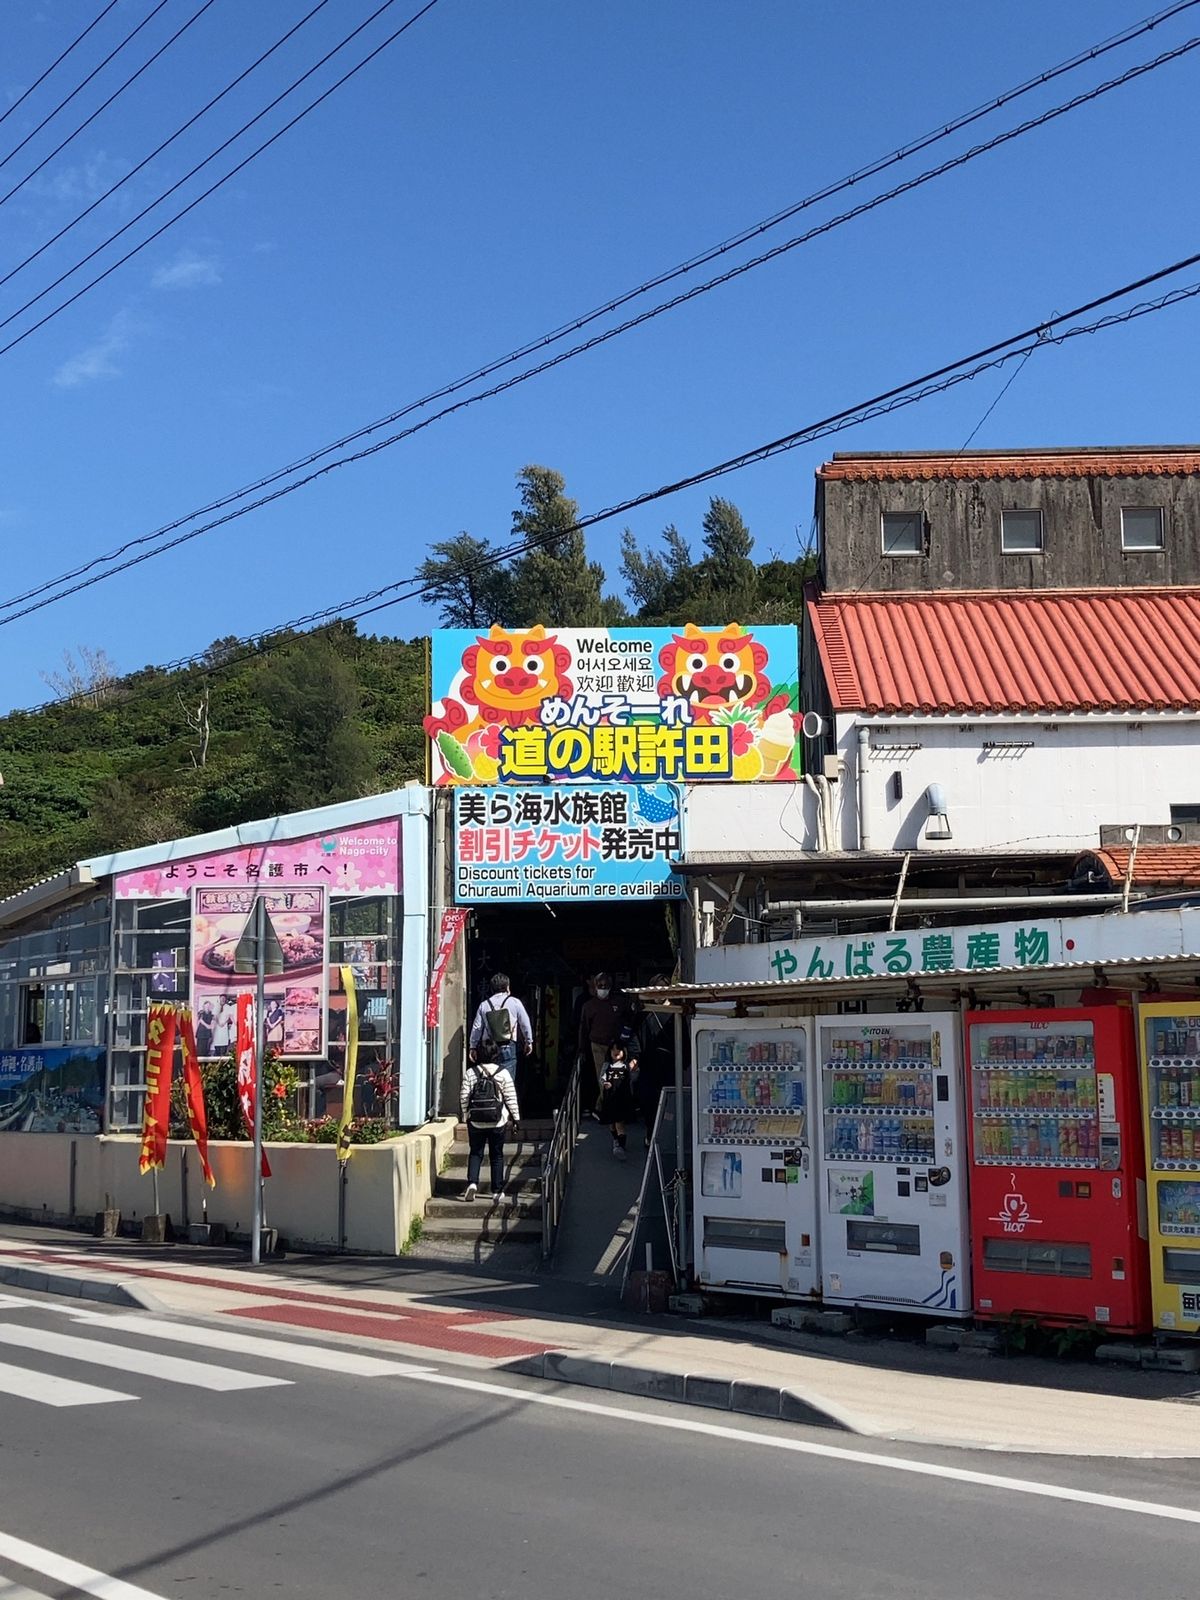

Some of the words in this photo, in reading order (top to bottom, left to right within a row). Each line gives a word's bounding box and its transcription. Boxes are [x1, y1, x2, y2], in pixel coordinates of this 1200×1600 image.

[576, 638, 652, 653] Welcome
[577, 657, 652, 672] 어서오세요
[576, 675, 613, 693] 欢迎
[540, 696, 693, 725] めんそーれ
[501, 726, 729, 776] 道の駅許田
[458, 792, 627, 826] 美ら海水族館
[340, 837, 385, 846] Welcome
[387, 837, 397, 845] to
[458, 827, 680, 862] 割引チケット発売中
[458, 866, 519, 879] Discount
[523, 866, 571, 879] tickets
[576, 865, 595, 878] for
[458, 883, 521, 897] Churaumi
[526, 883, 589, 897] Aquarium
[594, 885, 616, 896] are
[620, 882, 681, 896] available
[770, 927, 1050, 982] やんばる農産物
